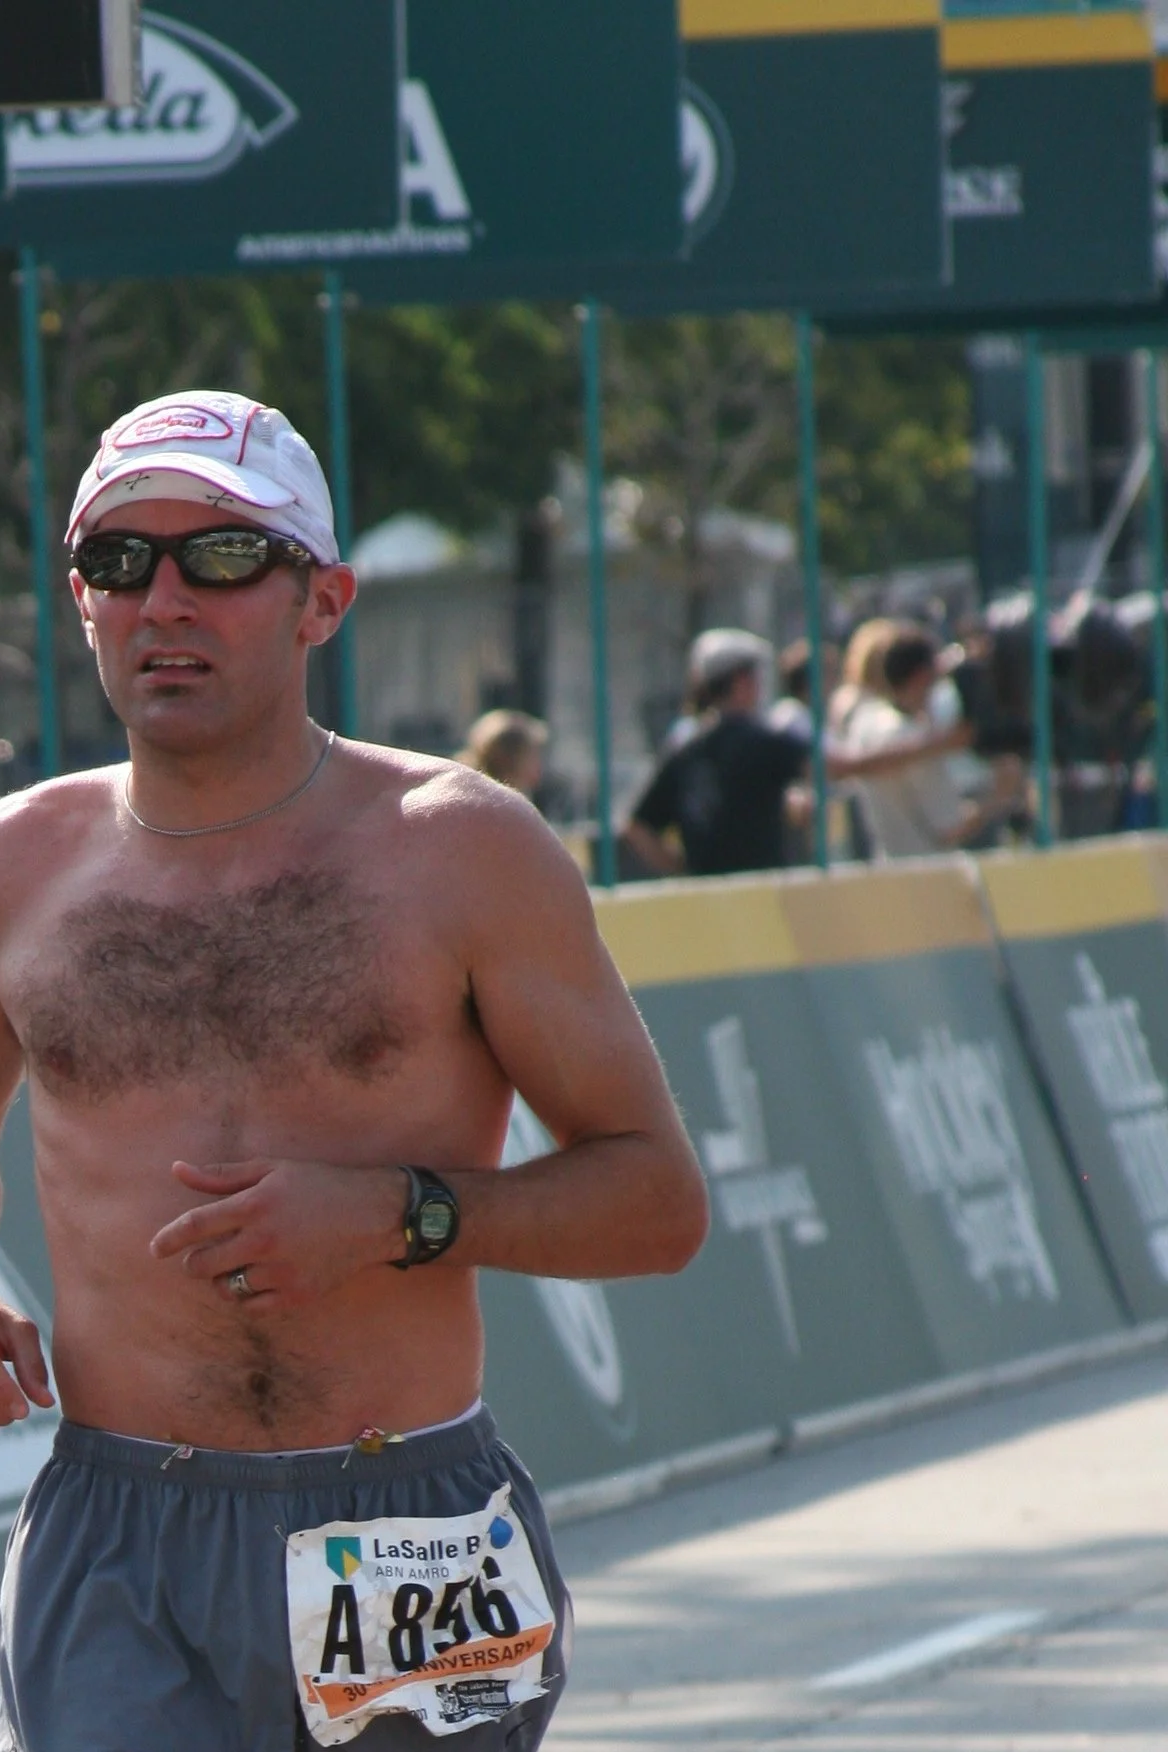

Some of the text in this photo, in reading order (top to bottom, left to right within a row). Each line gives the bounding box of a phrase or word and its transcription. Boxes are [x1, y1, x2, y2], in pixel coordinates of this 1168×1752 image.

[374, 1537, 459, 1561] LaSalle
[376, 1566, 450, 1580] ABN AMRO
[320, 1556, 520, 1675] A 856
